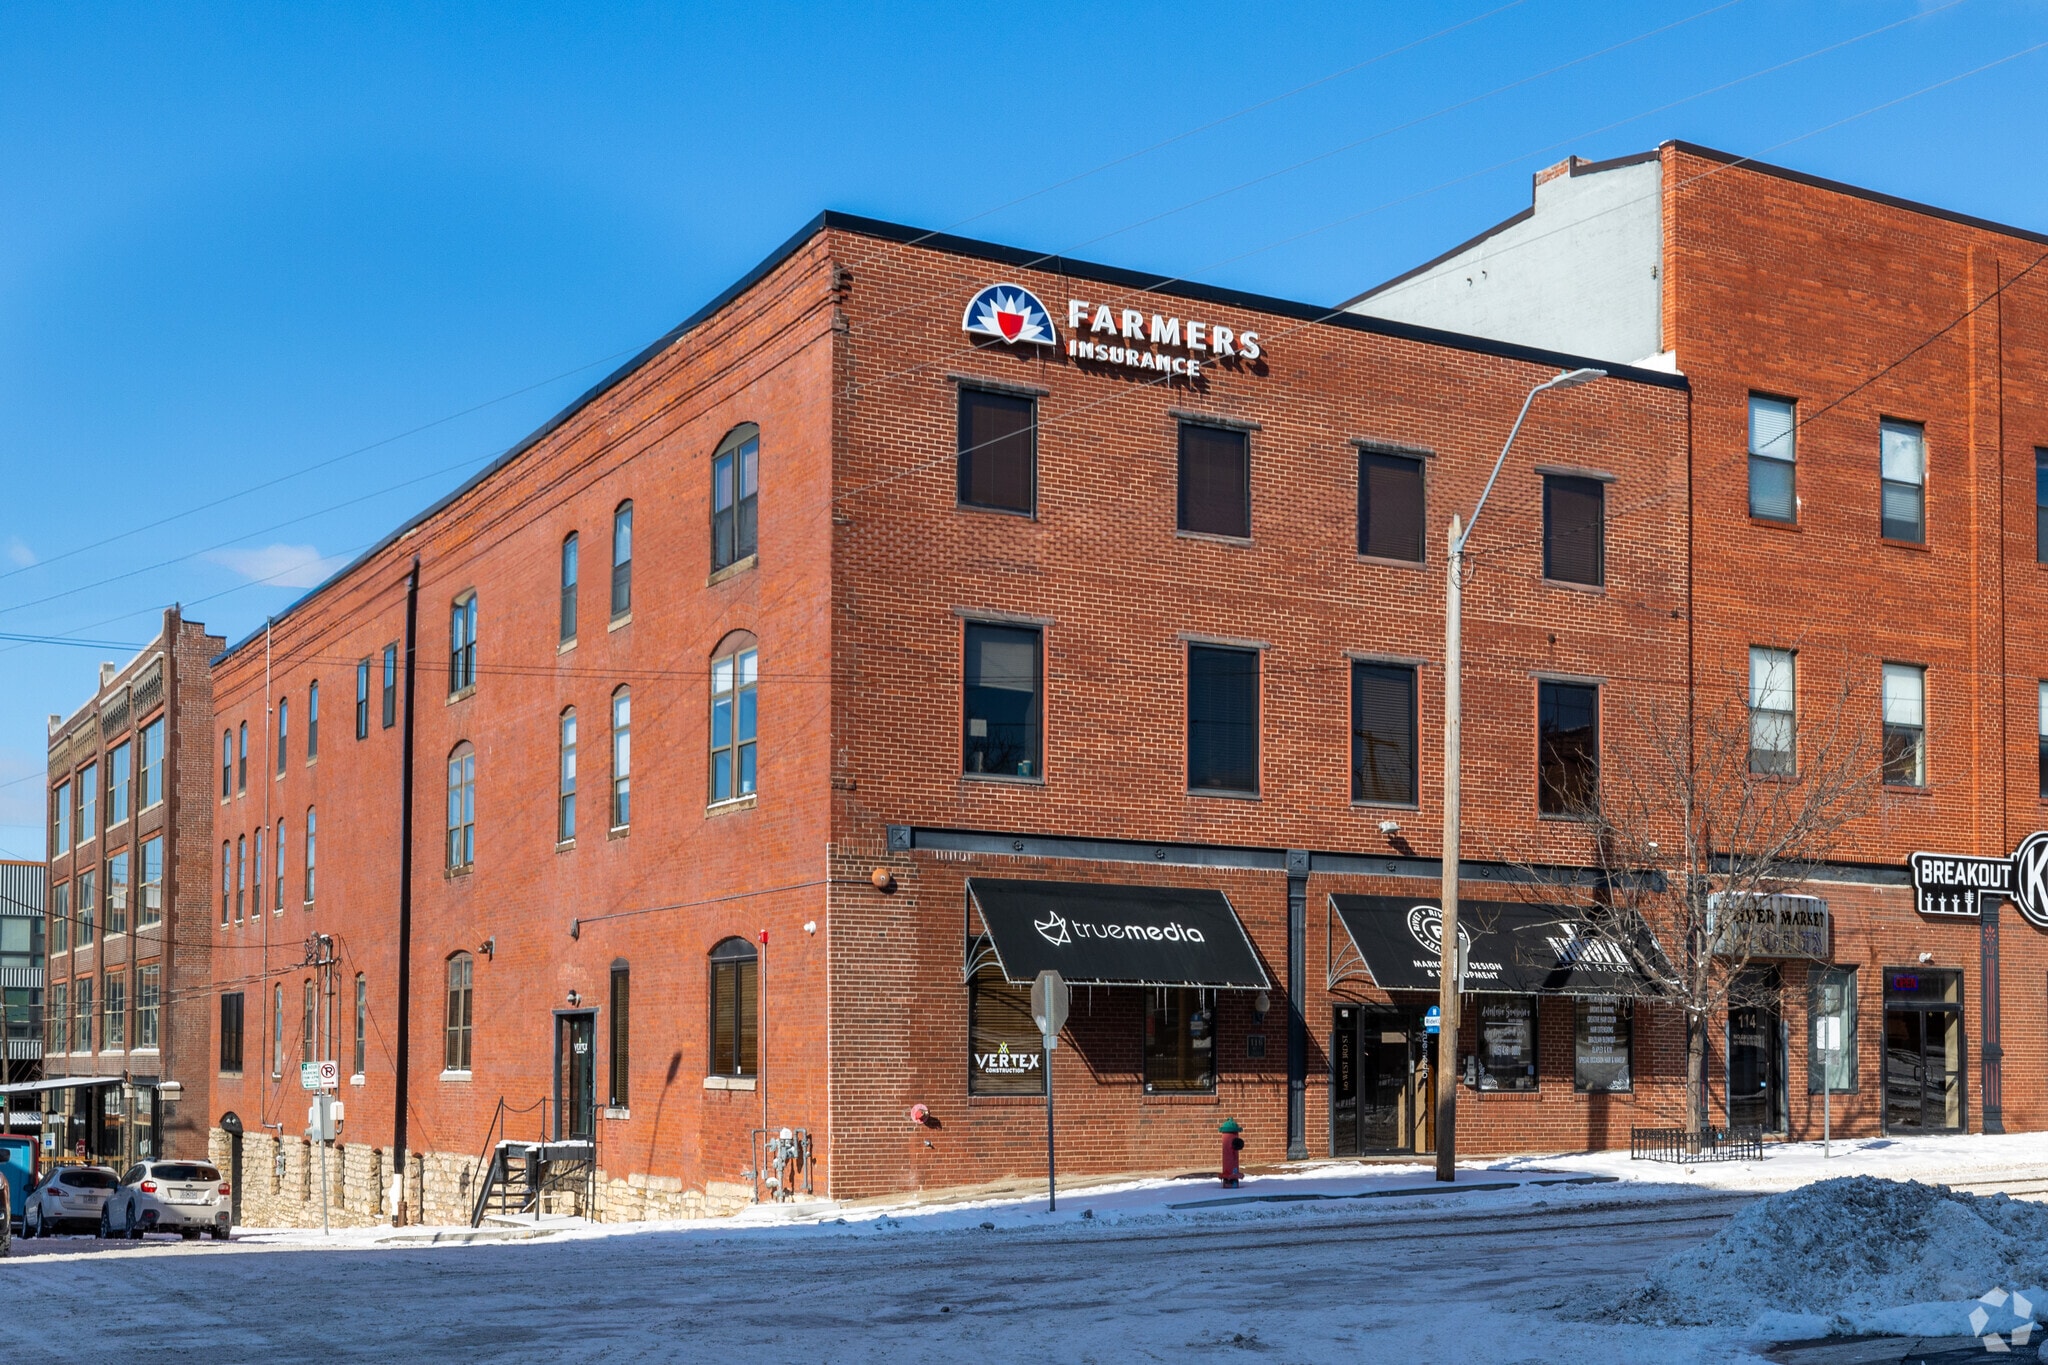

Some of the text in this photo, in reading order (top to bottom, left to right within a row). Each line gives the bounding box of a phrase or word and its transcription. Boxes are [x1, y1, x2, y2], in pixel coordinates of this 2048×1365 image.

[1068, 299, 1260, 360] FARMERS
[1068, 339, 1200, 377] INSURANCE
[1921, 843, 2048, 915] BREAKOUT K
[1411, 910, 1423, 932] RIVET
[1780, 910, 1824, 928] MARKET
[1071, 919, 1206, 943] truemedia
[1427, 970, 1436, 978] &
[1469, 962, 1503, 971] DESIGN
[1562, 963, 1635, 974] HAIR SALON
[1895, 977, 1917, 989] OPEN
[1738, 1014, 1756, 1028] 114
[974, 1053, 1040, 1070] VERTEX
